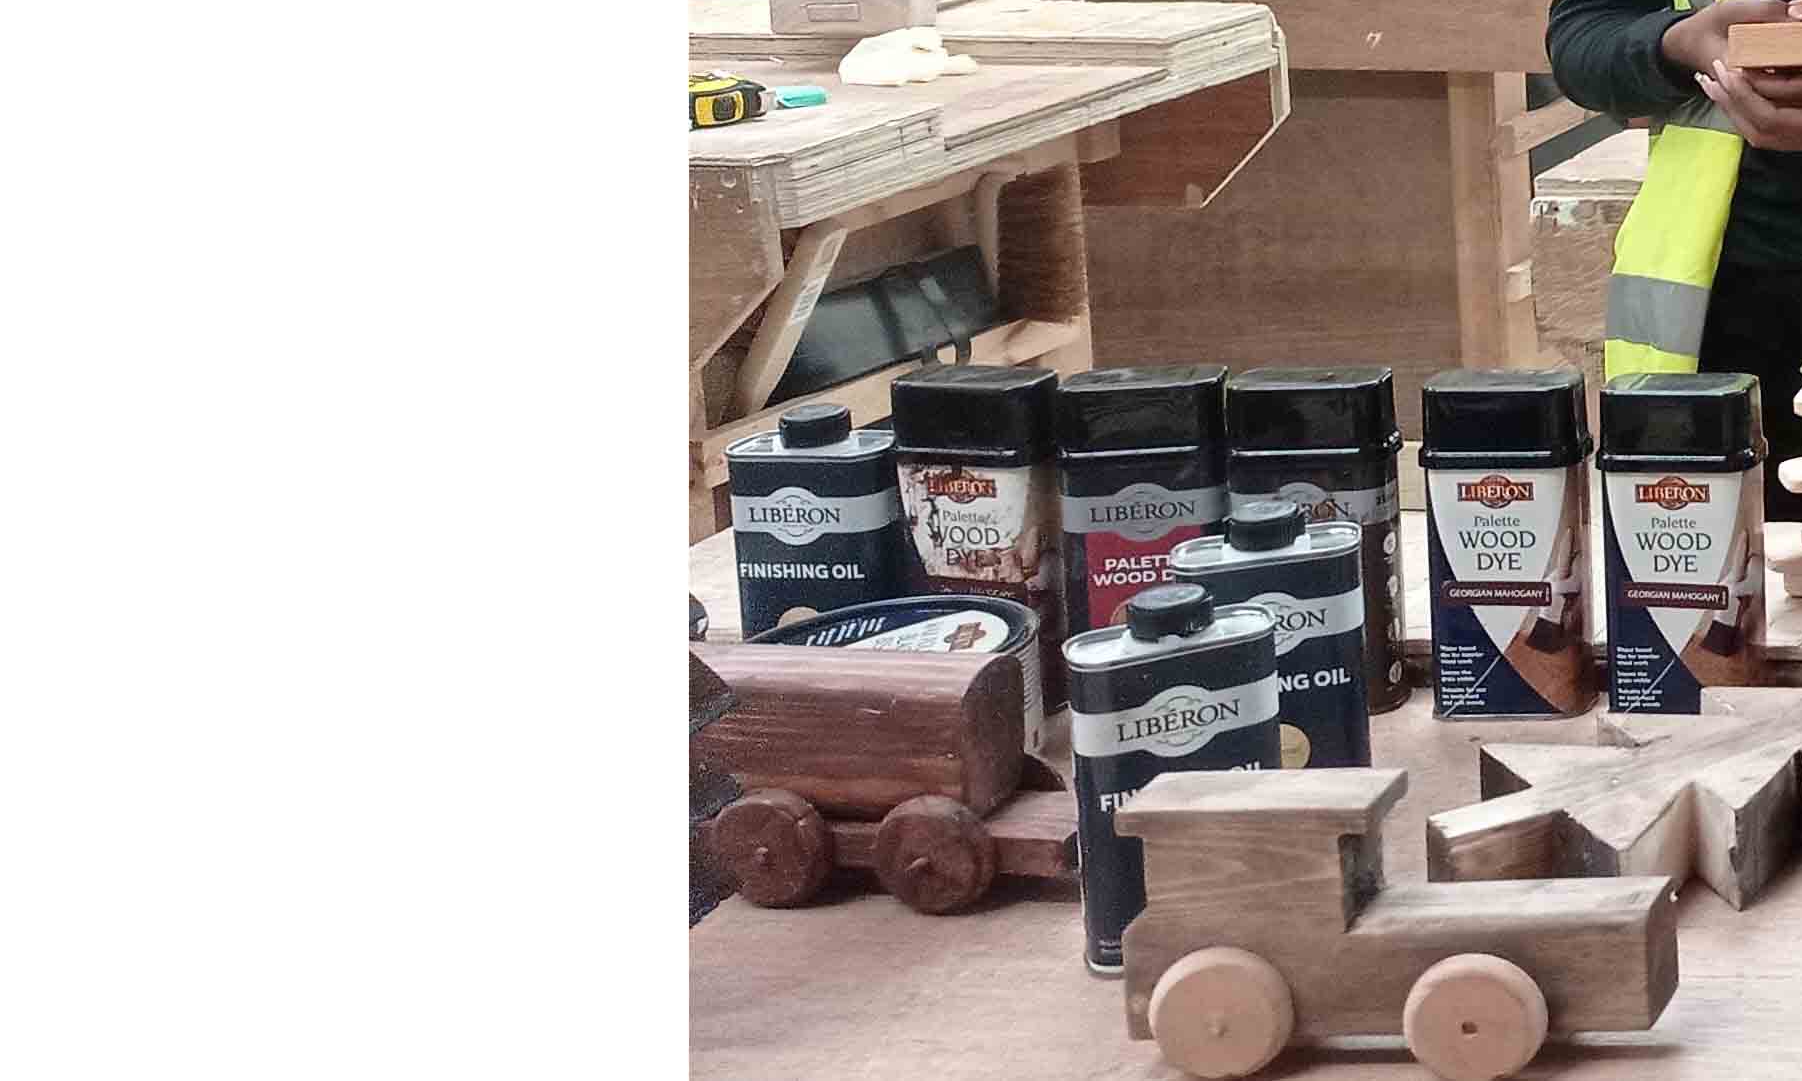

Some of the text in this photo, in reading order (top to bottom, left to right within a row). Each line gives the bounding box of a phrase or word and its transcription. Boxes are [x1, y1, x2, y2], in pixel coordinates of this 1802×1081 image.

[1639, 486, 1706, 502] LIBERON
[749, 504, 841, 525] LIBÉRON
[1090, 500, 1195, 523] LIBÉRON
[1474, 515, 1521, 527] Palette
[1651, 516, 1697, 529] Palette
[1458, 530, 1536, 549] WOOD
[1635, 532, 1711, 550] WOOD
[1104, 554, 1171, 571] PALETT
[1477, 552, 1522, 570] DYE
[1654, 554, 1698, 572] DYE
[739, 563, 865, 579] FINISHING OIL
[1093, 570, 1156, 587] WOOD
[1449, 588, 1543, 599] GEORGIAN MAHOGANY
[1627, 589, 1720, 602] GEORGIAN MAHOGANY
[1314, 668, 1351, 687] OIL
[1117, 699, 1241, 742] LIBÉRON
